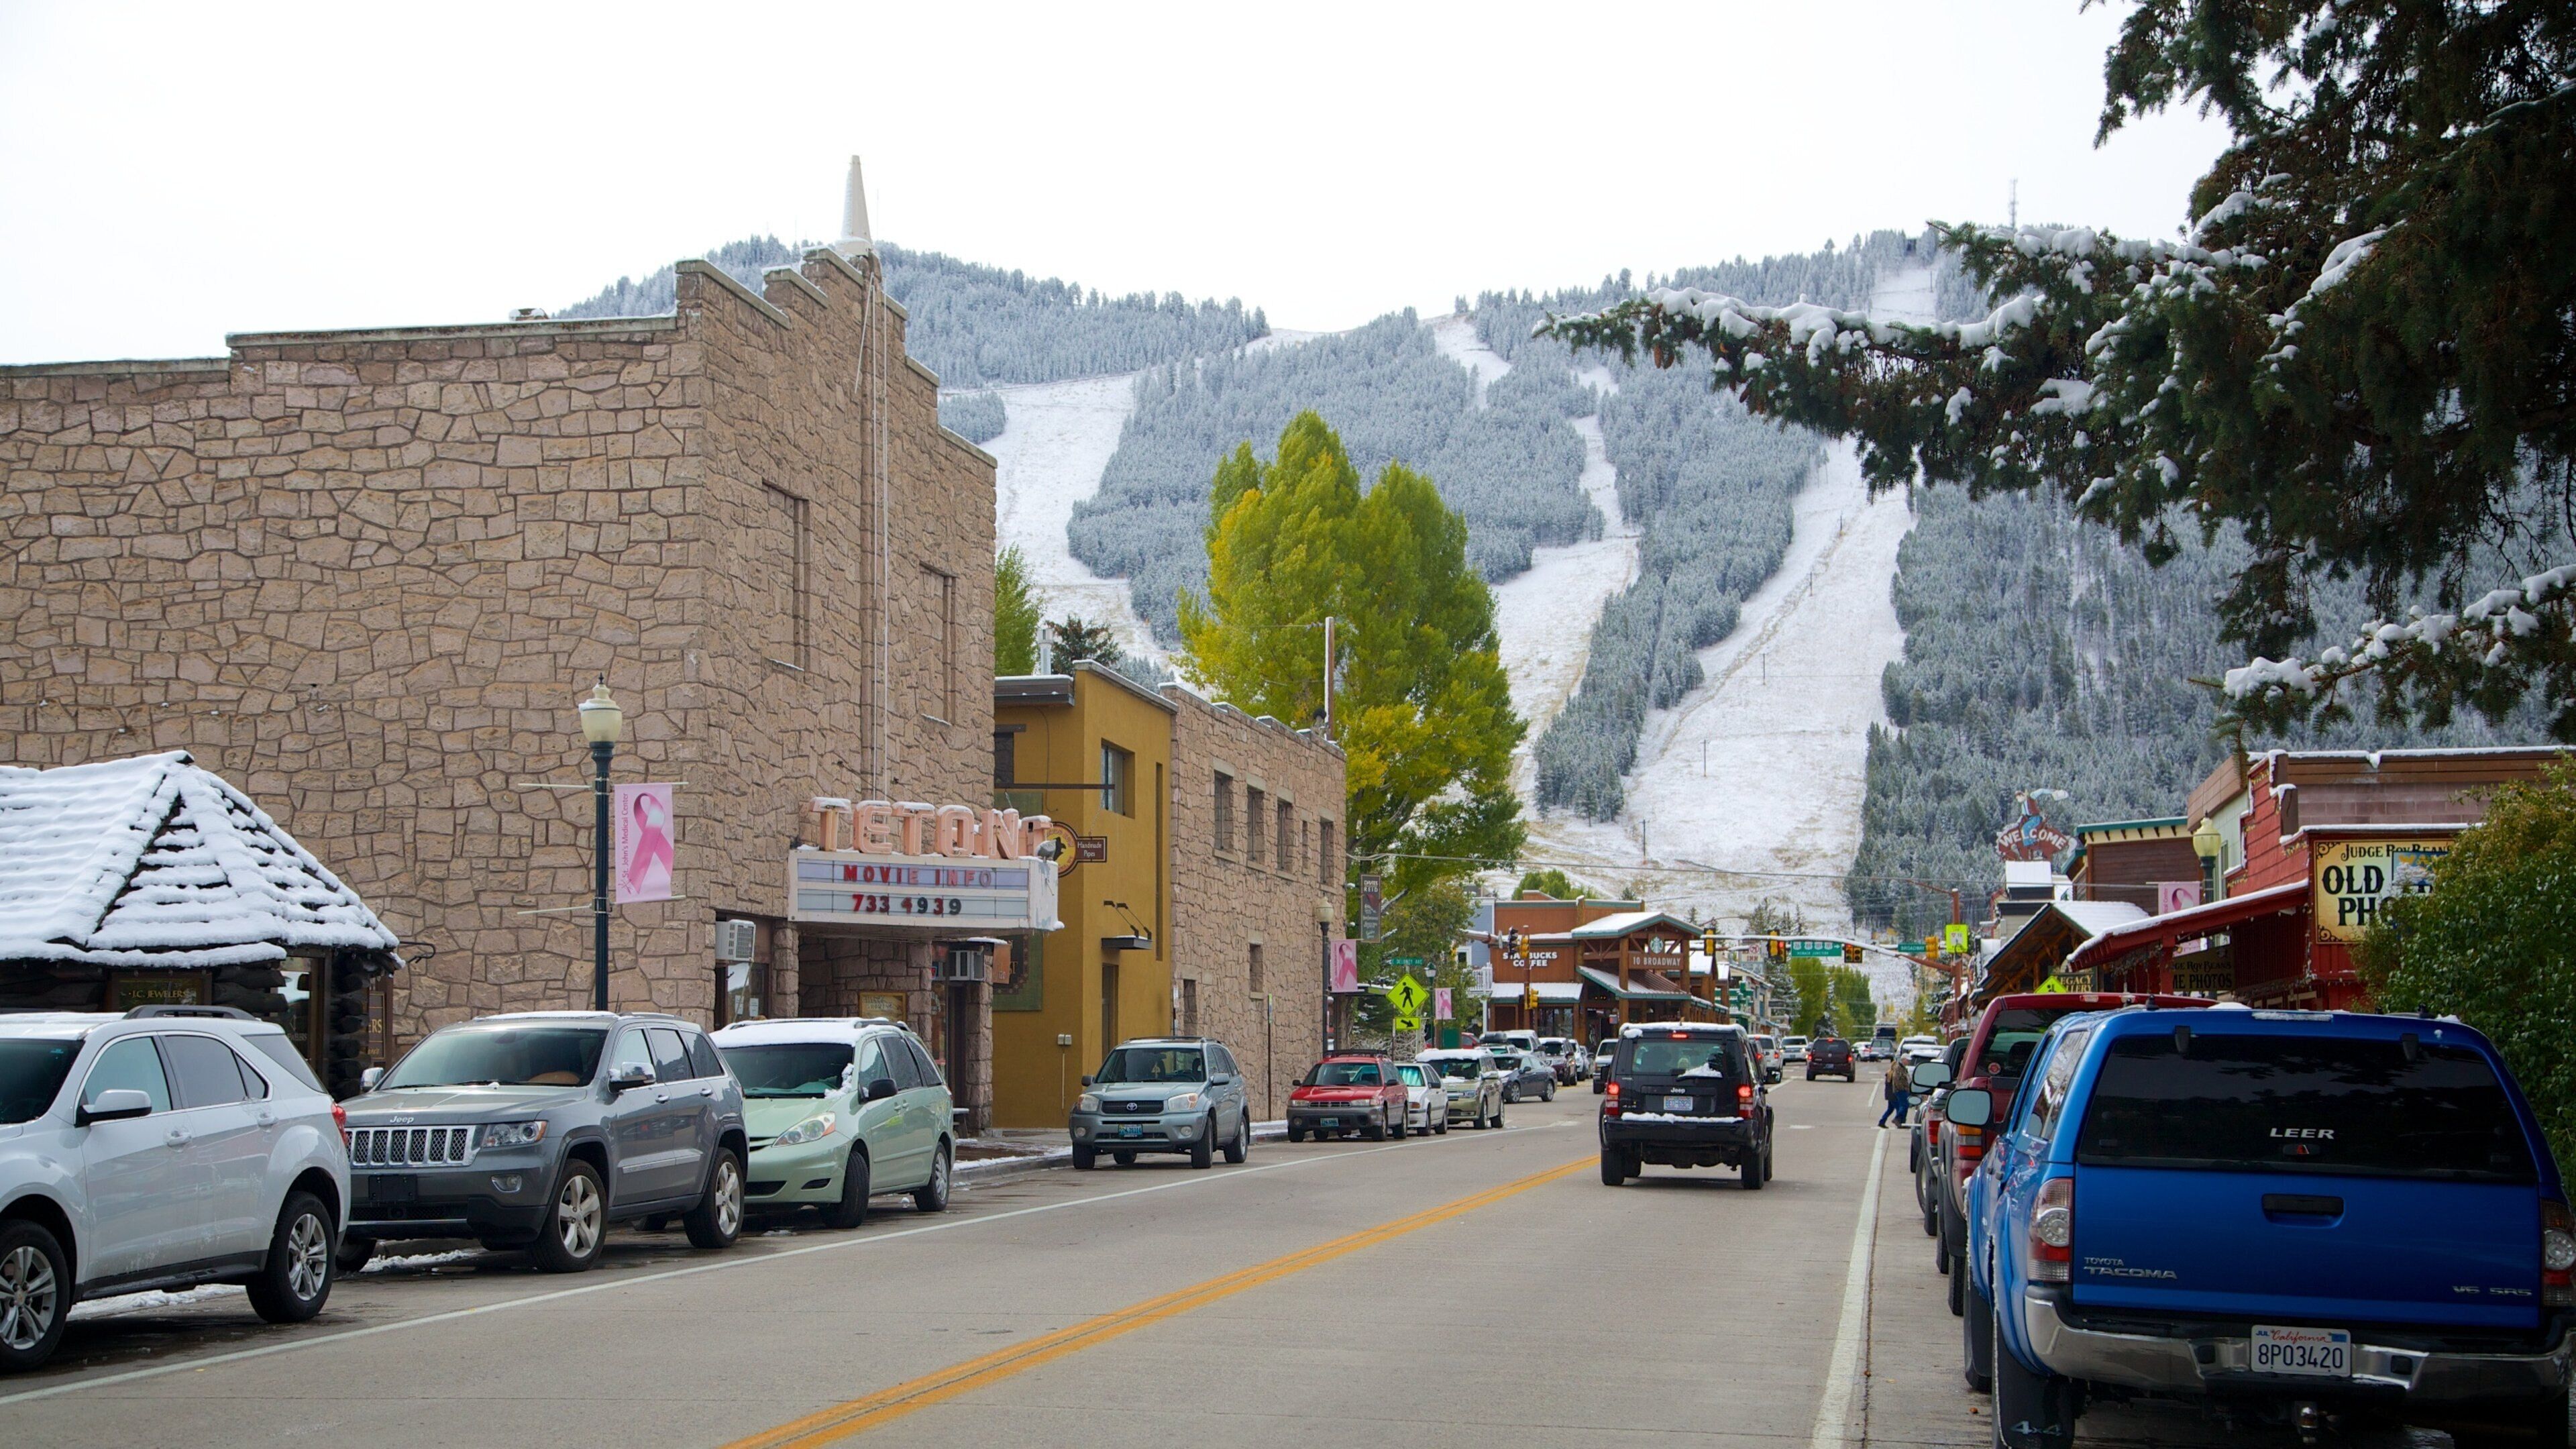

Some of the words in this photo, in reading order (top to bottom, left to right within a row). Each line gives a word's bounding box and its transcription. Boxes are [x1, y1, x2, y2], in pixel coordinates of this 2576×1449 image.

[810, 800, 1019, 859] TETON
[1999, 829, 2066, 849] WELCOME
[2341, 844, 2383, 861] JUDGE
[844, 864, 918, 885] MOVIE
[936, 869, 991, 887] INFO
[2322, 865, 2384, 894] OLD
[853, 894, 890, 913] 733
[902, 897, 961, 915] 4939
[1633, 957, 1640, 965] 10
[1644, 957, 1681, 966] BROADWAY
[2189, 973, 2233, 989] PHOTOS
[390, 1116, 415, 1124] Jeep
[2269, 1128, 2334, 1139] LEER
[2084, 1257, 2125, 1267] TOYOTA
[2083, 1266, 2178, 1279] TACOMA
[2271, 1330, 2332, 1344] California
[2259, 1344, 2343, 1369] 8P03420
[2011, 1420, 2062, 1436] 4x4
